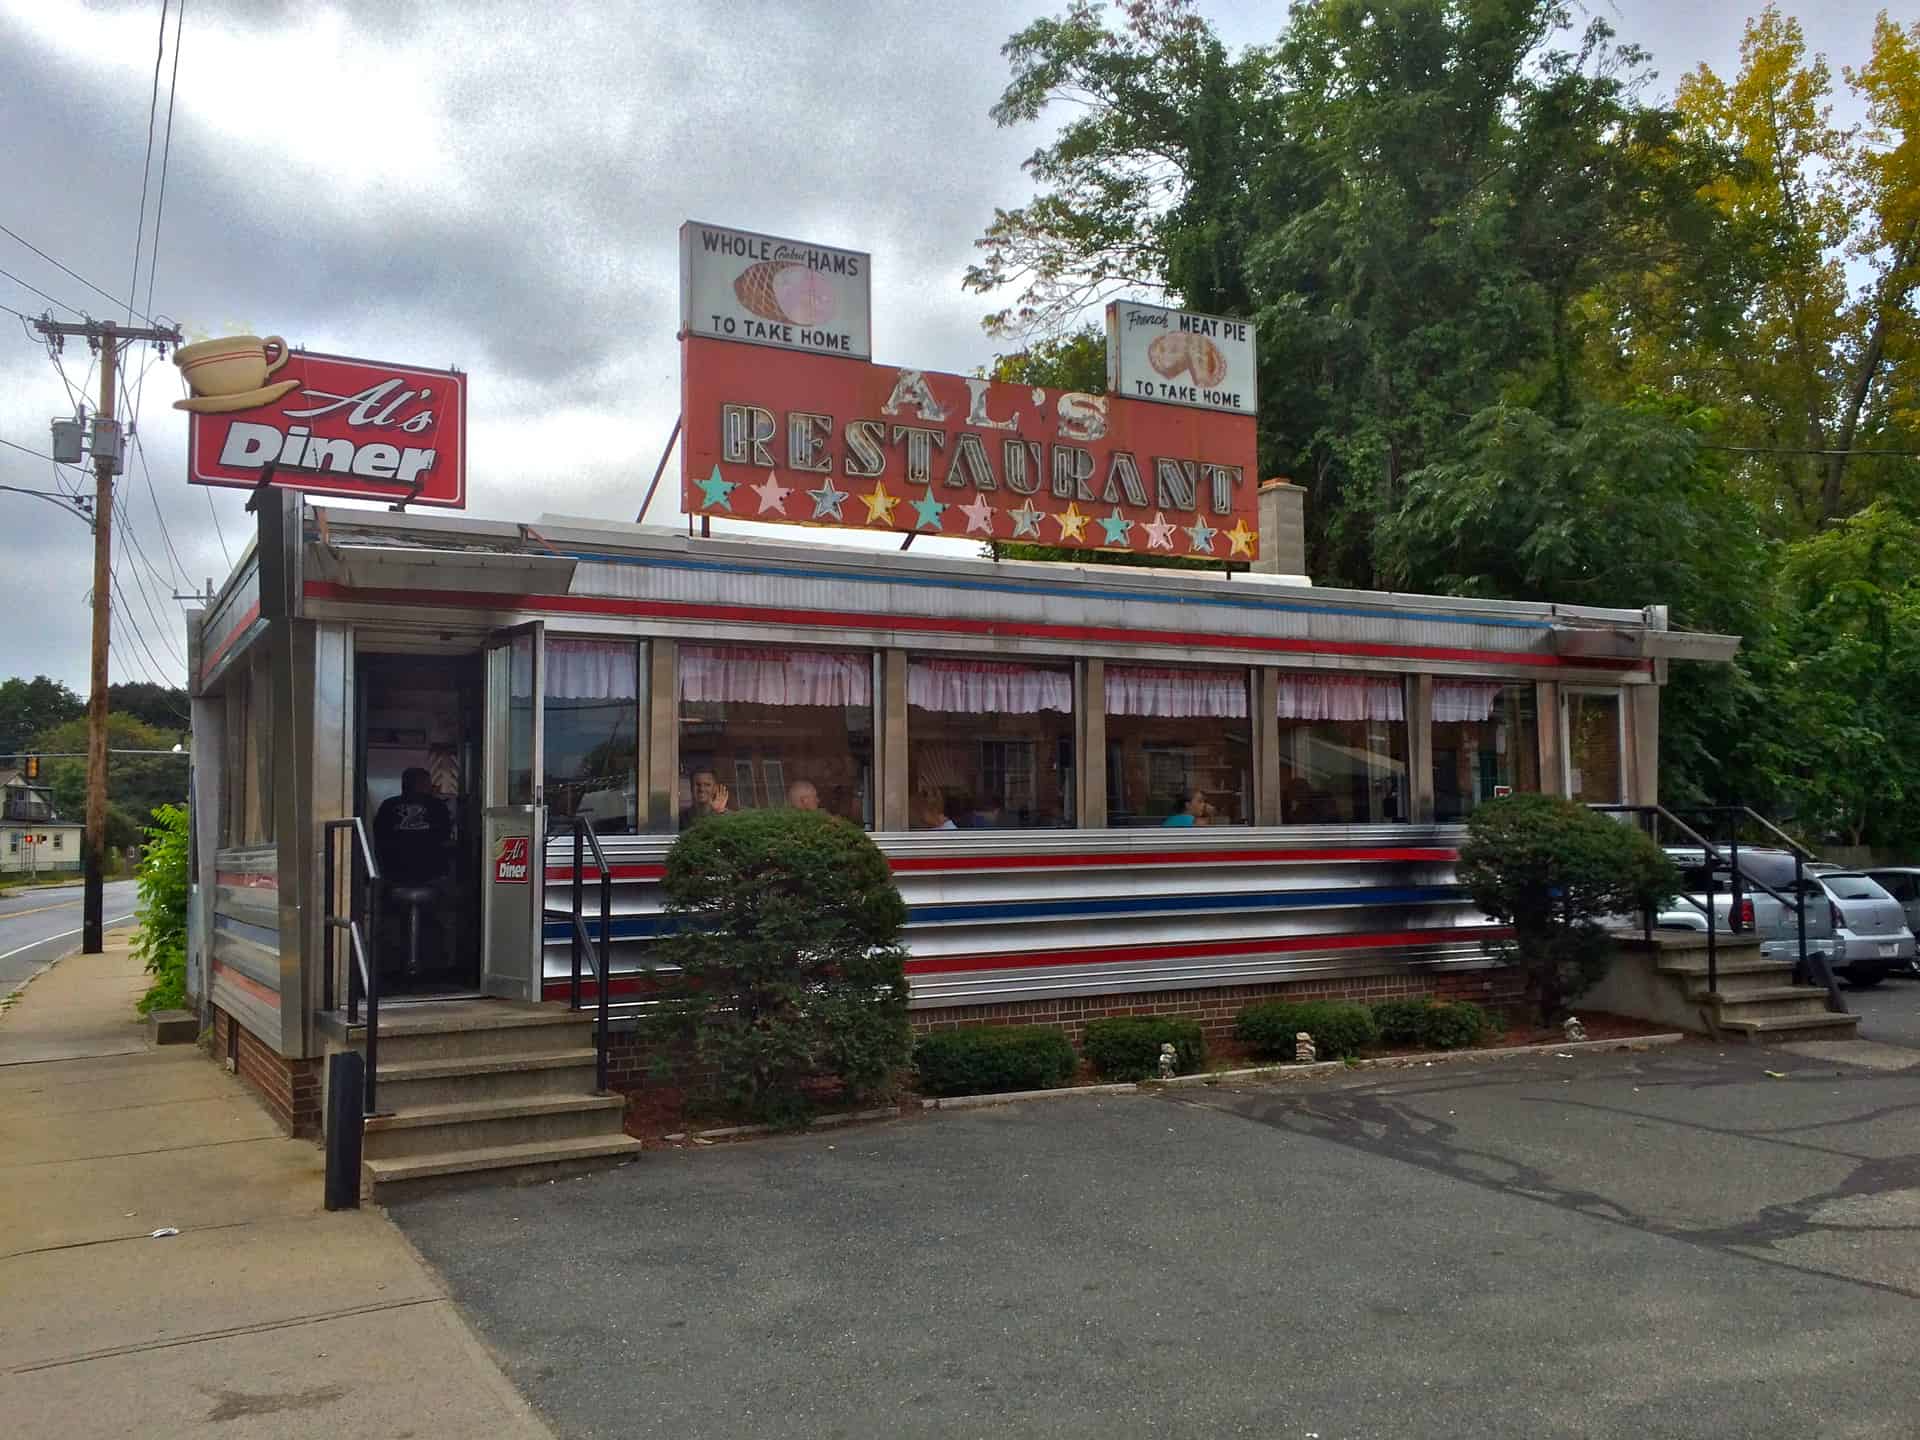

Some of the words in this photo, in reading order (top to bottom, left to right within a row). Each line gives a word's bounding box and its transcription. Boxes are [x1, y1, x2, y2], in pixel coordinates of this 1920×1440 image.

[702, 231, 771, 261] WHOLE
[807, 248, 860, 276] HAMS
[711, 315, 736, 334] TO
[743, 320, 793, 343] TAKE
[801, 328, 850, 350] HOME
[1126, 310, 1169, 332] French
[1179, 314, 1219, 337] MEAT
[1223, 323, 1246, 342] PIE
[282, 378, 433, 433] Al's
[881, 367, 1108, 441] AL'S
[1136, 380, 1154, 396] TO
[1160, 383, 1197, 402] TAKE
[1203, 390, 1241, 408] HOME
[217, 421, 437, 483] Diner
[721, 403, 1245, 516] RESTAURANT
[499, 862, 527, 879] Diner
